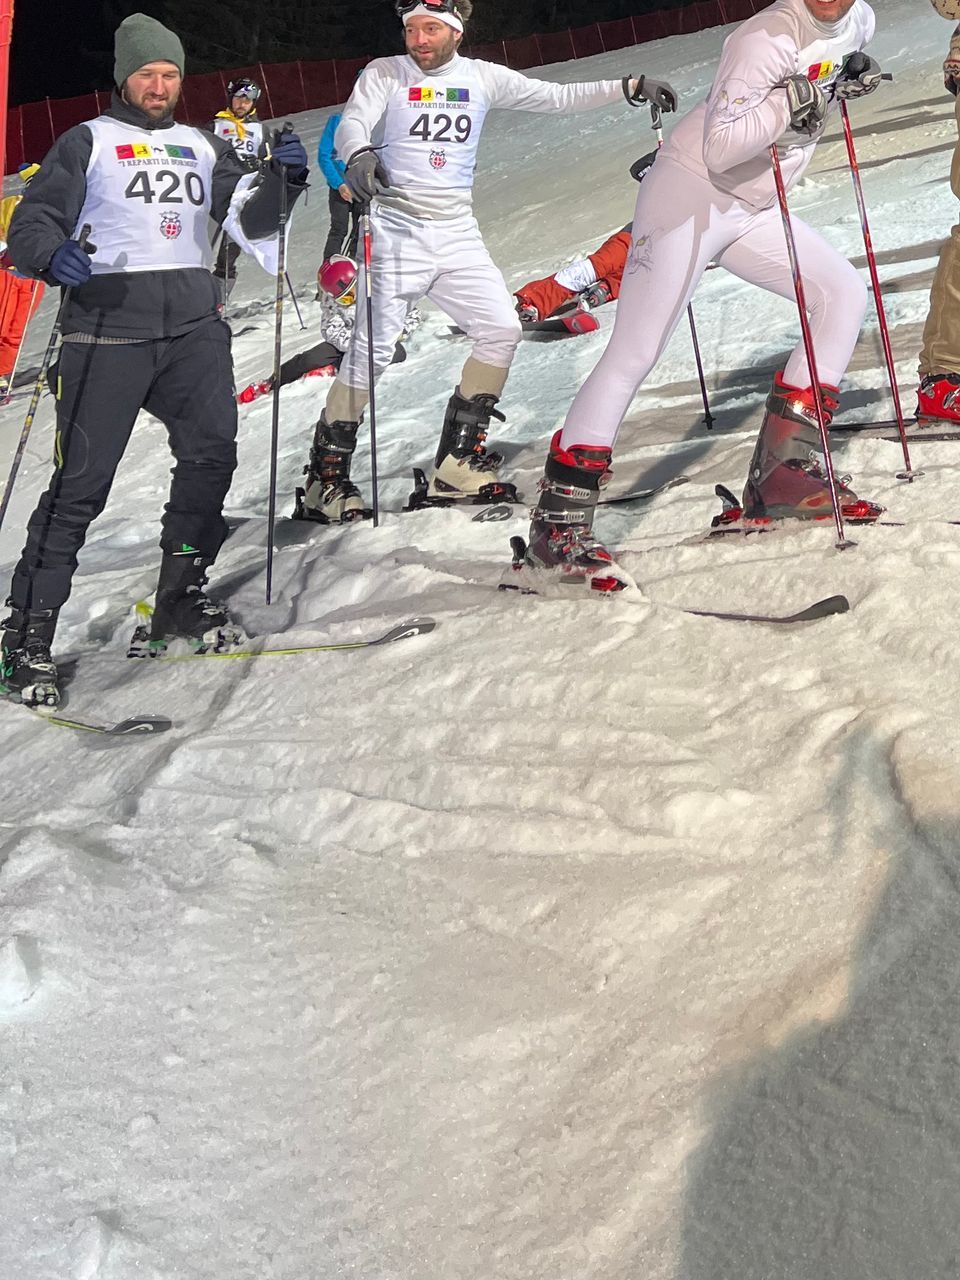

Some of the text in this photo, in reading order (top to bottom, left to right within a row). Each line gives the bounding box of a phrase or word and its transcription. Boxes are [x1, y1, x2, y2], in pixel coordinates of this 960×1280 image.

[409, 113, 472, 143] 429
[127, 158, 160, 167] REPARTI
[125, 170, 206, 207] 420
